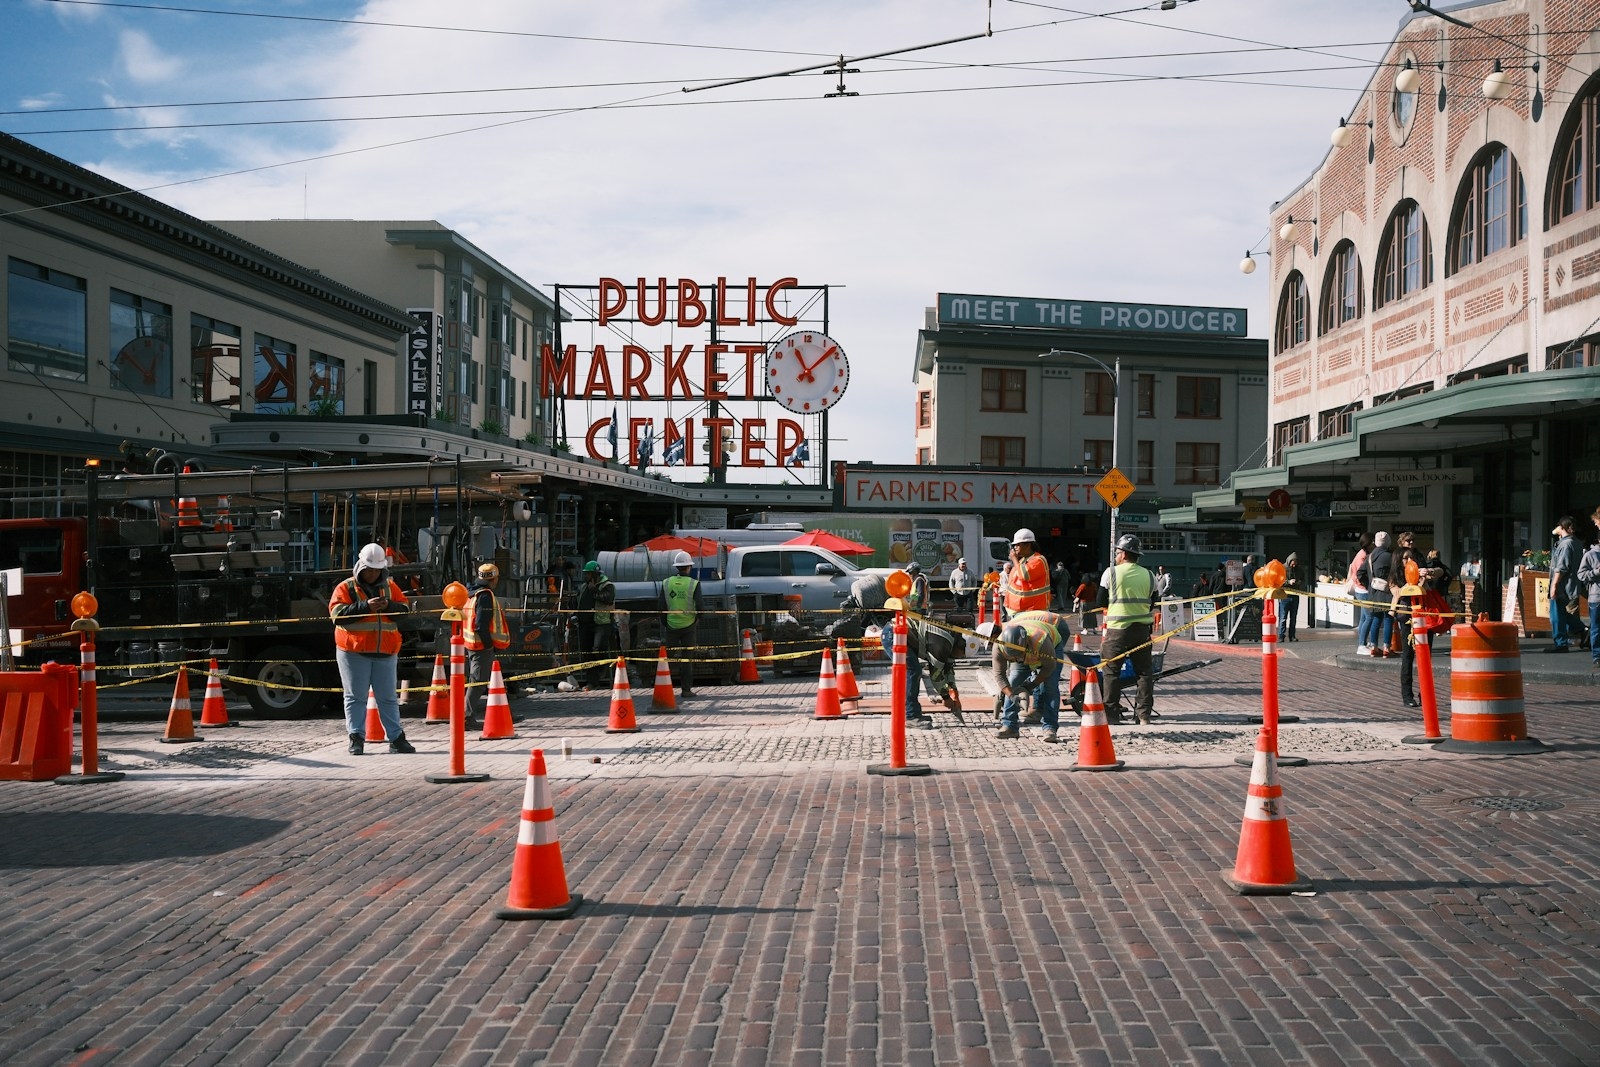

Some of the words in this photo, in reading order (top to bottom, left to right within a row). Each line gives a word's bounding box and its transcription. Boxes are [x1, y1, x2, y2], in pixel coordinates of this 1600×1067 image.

[599, 277, 797, 327] PUBLIC
[951, 298, 1019, 322] MEET
[1035, 303, 1082, 325] THE
[1100, 306, 1237, 331] PRODUCER
[804, 335, 812, 343] 12
[834, 352, 840, 360] 2
[1403, 346, 1467, 383] MARKET
[411, 339, 428, 393] SALLE
[540, 344, 767, 400] MARKET
[838, 369, 843, 377] 3
[775, 385, 781, 393] 8
[804, 402, 810, 410] 6
[585, 417, 804, 468] CENTER
[1423, 472, 1456, 481] books
[857, 480, 973, 503] FARMERS
[991, 482, 1095, 504] MARKET
[1381, 501, 1399, 512] Shop
